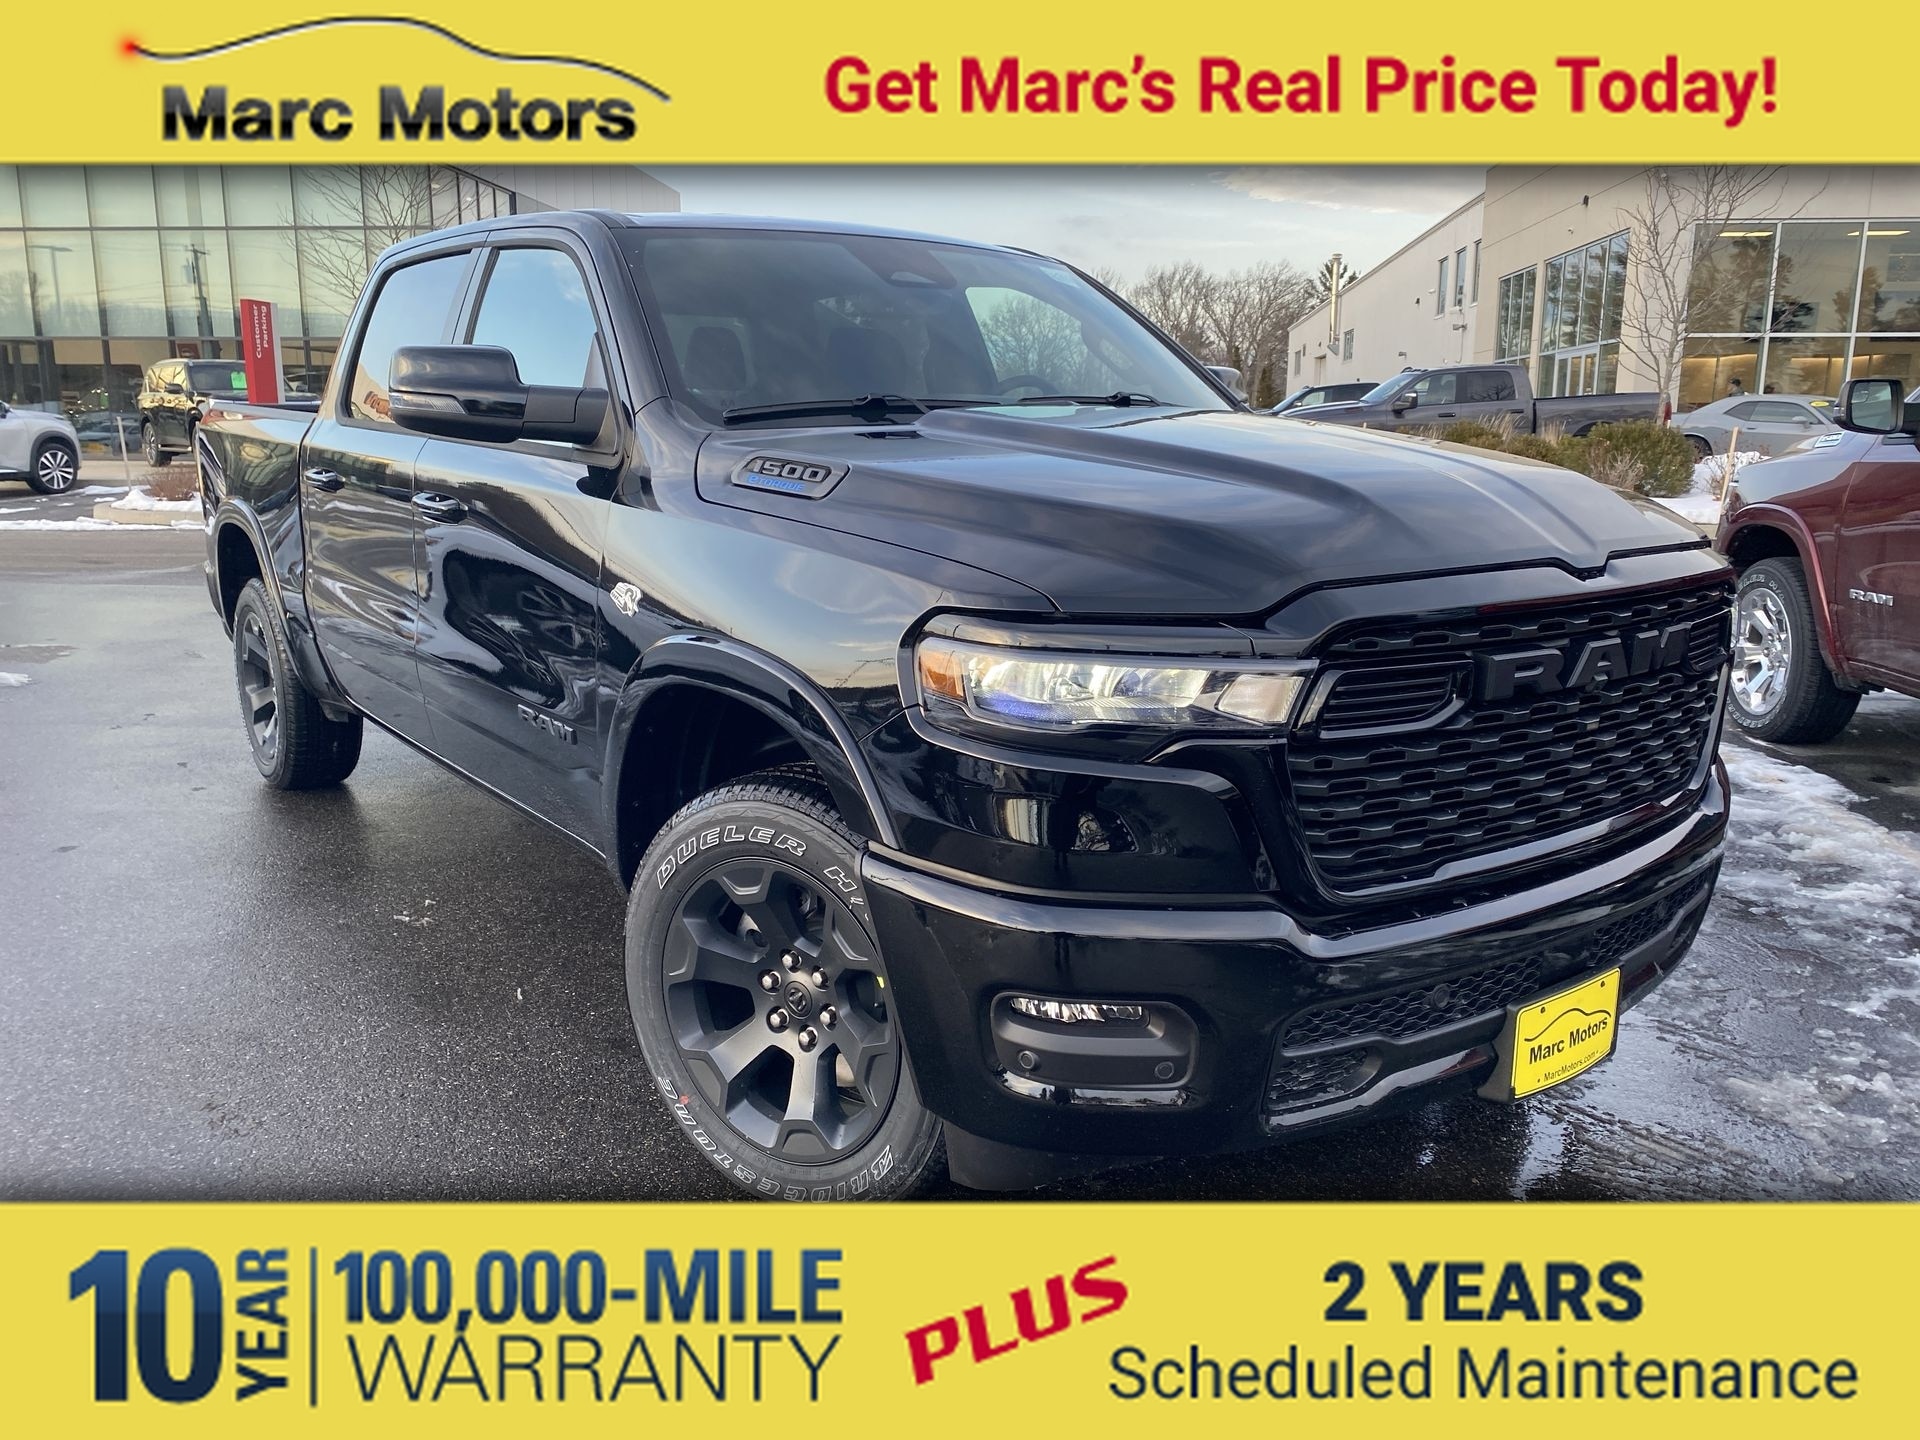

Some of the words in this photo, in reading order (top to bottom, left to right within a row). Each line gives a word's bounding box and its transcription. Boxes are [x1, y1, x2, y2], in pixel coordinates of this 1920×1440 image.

[253, 304, 262, 358] Customer
[752, 459, 826, 482] 1500
[1849, 589, 1893, 606] RAM
[1486, 623, 1688, 700] RAM
[517, 703, 578, 745] RAM
[656, 825, 807, 889] DUELER
[1529, 1039, 1565, 1065] Marc
[1569, 1016, 1608, 1049] Motors
[1543, 1051, 1597, 1083] MarcMotors.com
[658, 1076, 895, 1202] BRIDGESTONE
